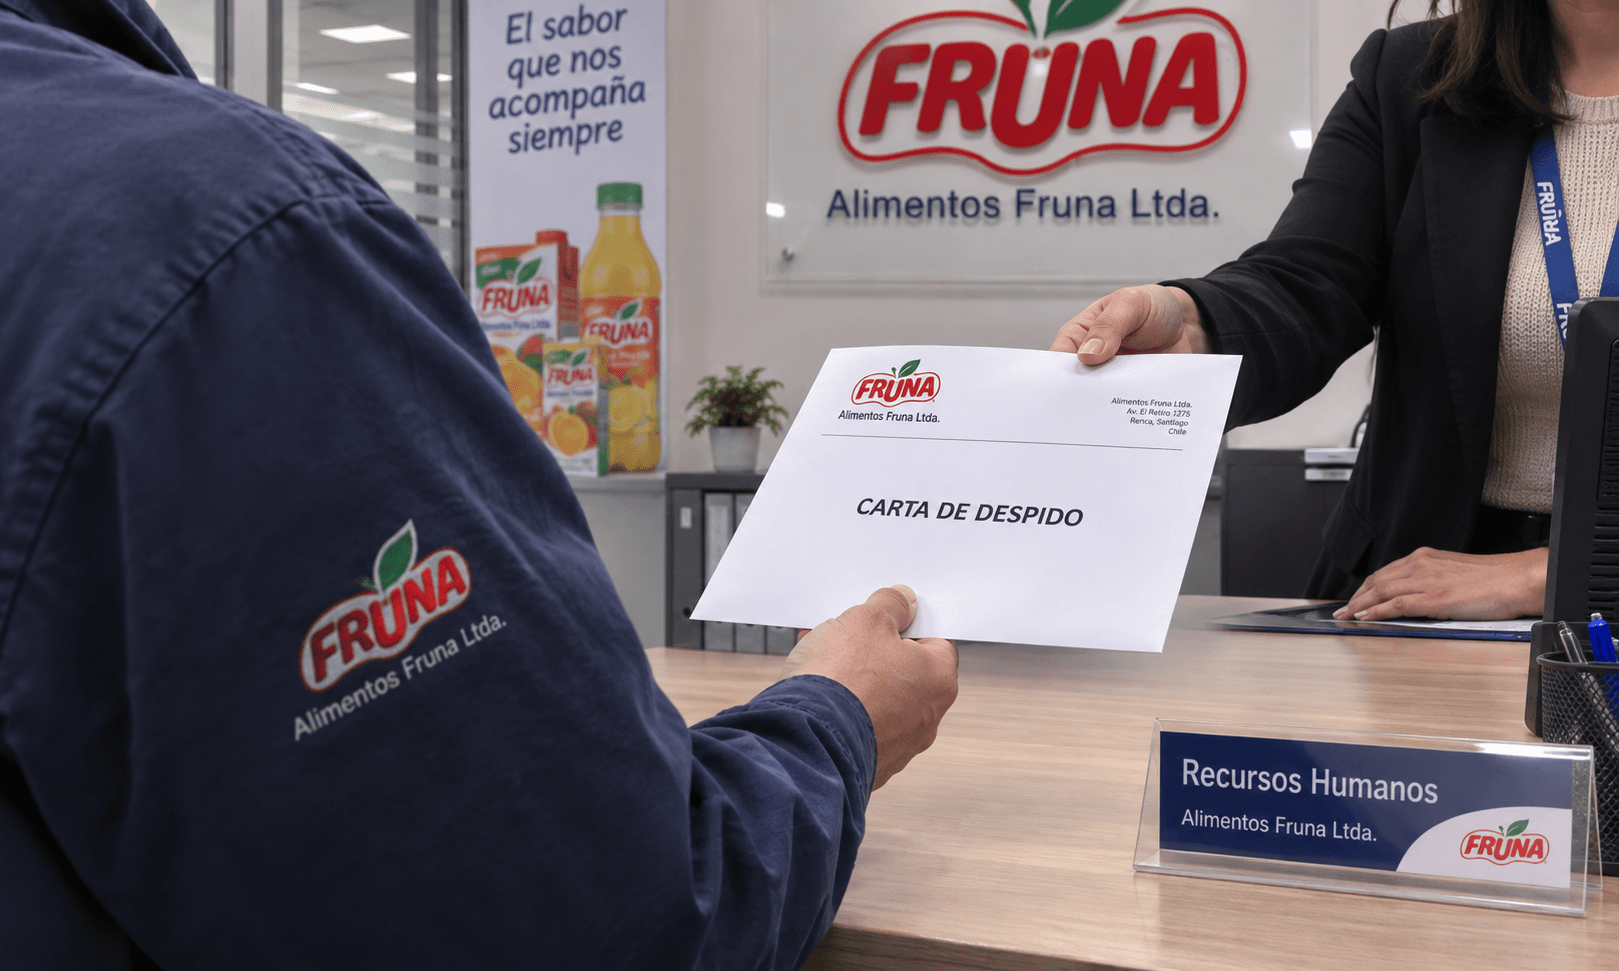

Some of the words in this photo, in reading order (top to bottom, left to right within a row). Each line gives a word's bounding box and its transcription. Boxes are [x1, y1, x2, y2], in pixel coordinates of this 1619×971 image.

[506, 11, 533, 45] El
[542, 4, 628, 41] sabor
[507, 53, 561, 89] que
[570, 45, 622, 74] nos
[488, 75, 646, 120] acompaña
[858, 31, 1220, 149] FRUNA
[507, 119, 623, 156] siempre
[826, 189, 1000, 219] Alimentos
[1016, 189, 1117, 219] Fruna
[1132, 188, 1219, 219] Ltda.
[482, 284, 550, 313] FRUNA
[589, 321, 649, 344] FRUNA
[547, 367, 593, 385] FRUNA
[855, 376, 935, 403] FRUNA
[838, 410, 884, 421] Alimentos
[886, 411, 913, 422] Fruna
[916, 412, 940, 423] Ltda.
[1111, 397, 1148, 406] Alimentos
[1150, 399, 1172, 407] Fruna
[1148, 409, 1171, 417] Retiro
[1130, 417, 1154, 426] Renca,
[1156, 418, 1189, 427] Santiago
[856, 498, 929, 519] CARTA
[936, 502, 971, 521] DE
[974, 504, 1084, 527] DESPIDO
[310, 554, 467, 684] FRUNA
[294, 671, 401, 741] Alimentos
[402, 638, 459, 680] Fruna
[460, 615, 507, 647] Ltda.
[1183, 758, 1302, 794] Recursos
[1311, 768, 1438, 804] Humanos
[1181, 809, 1269, 832] Alimentos
[1275, 816, 1326, 838] Fruna
[1333, 821, 1377, 842] Ltda.
[1464, 835, 1544, 861] FRUNA
